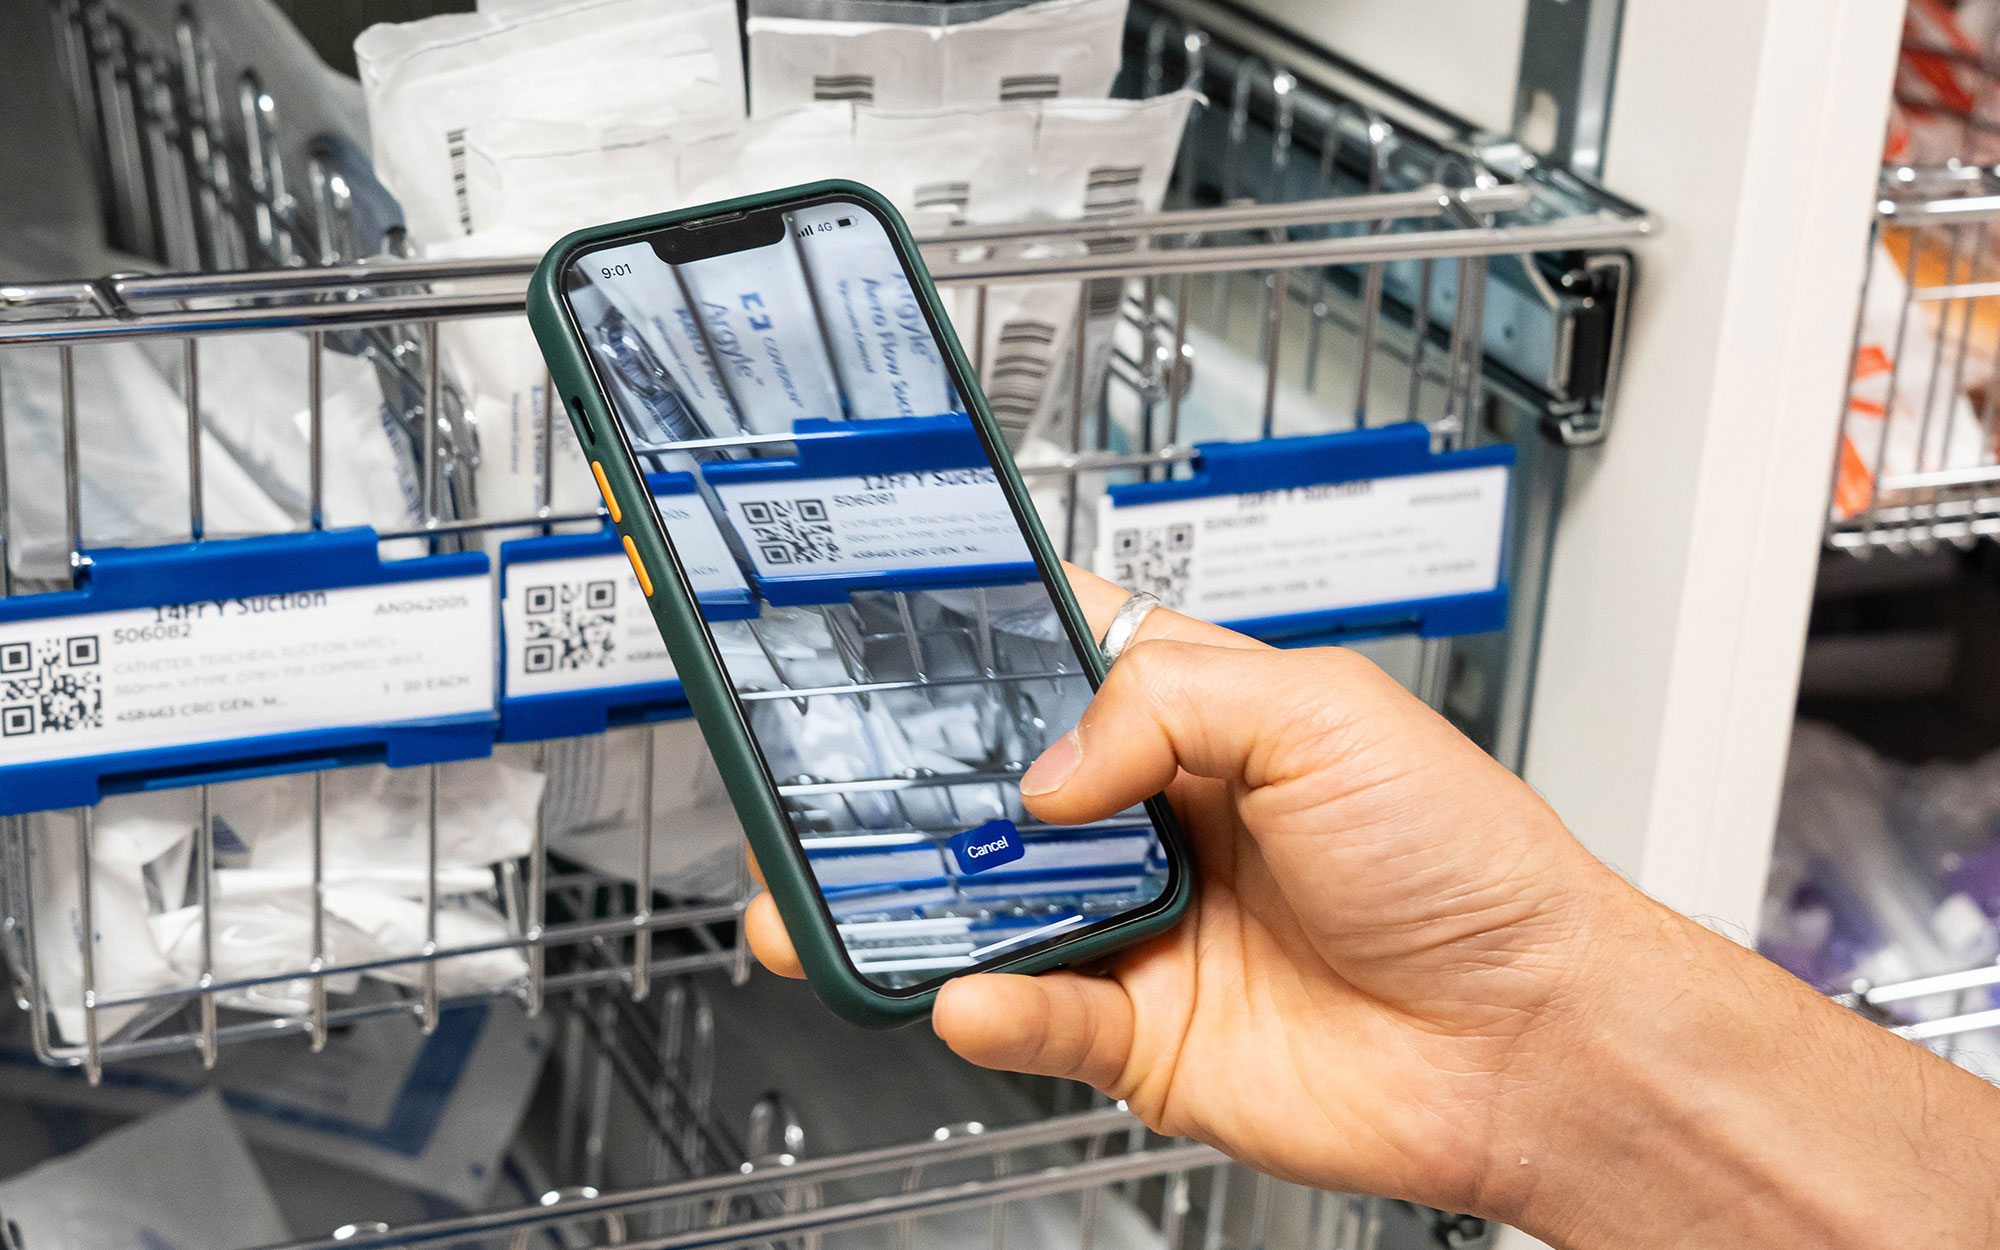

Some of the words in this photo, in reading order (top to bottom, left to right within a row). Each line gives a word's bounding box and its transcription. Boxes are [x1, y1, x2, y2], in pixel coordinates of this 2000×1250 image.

[817, 222, 833, 233] 4G
[601, 263, 633, 279] 9:01
[237, 590, 328, 616] Suction
[967, 835, 1010, 859] Cancel
